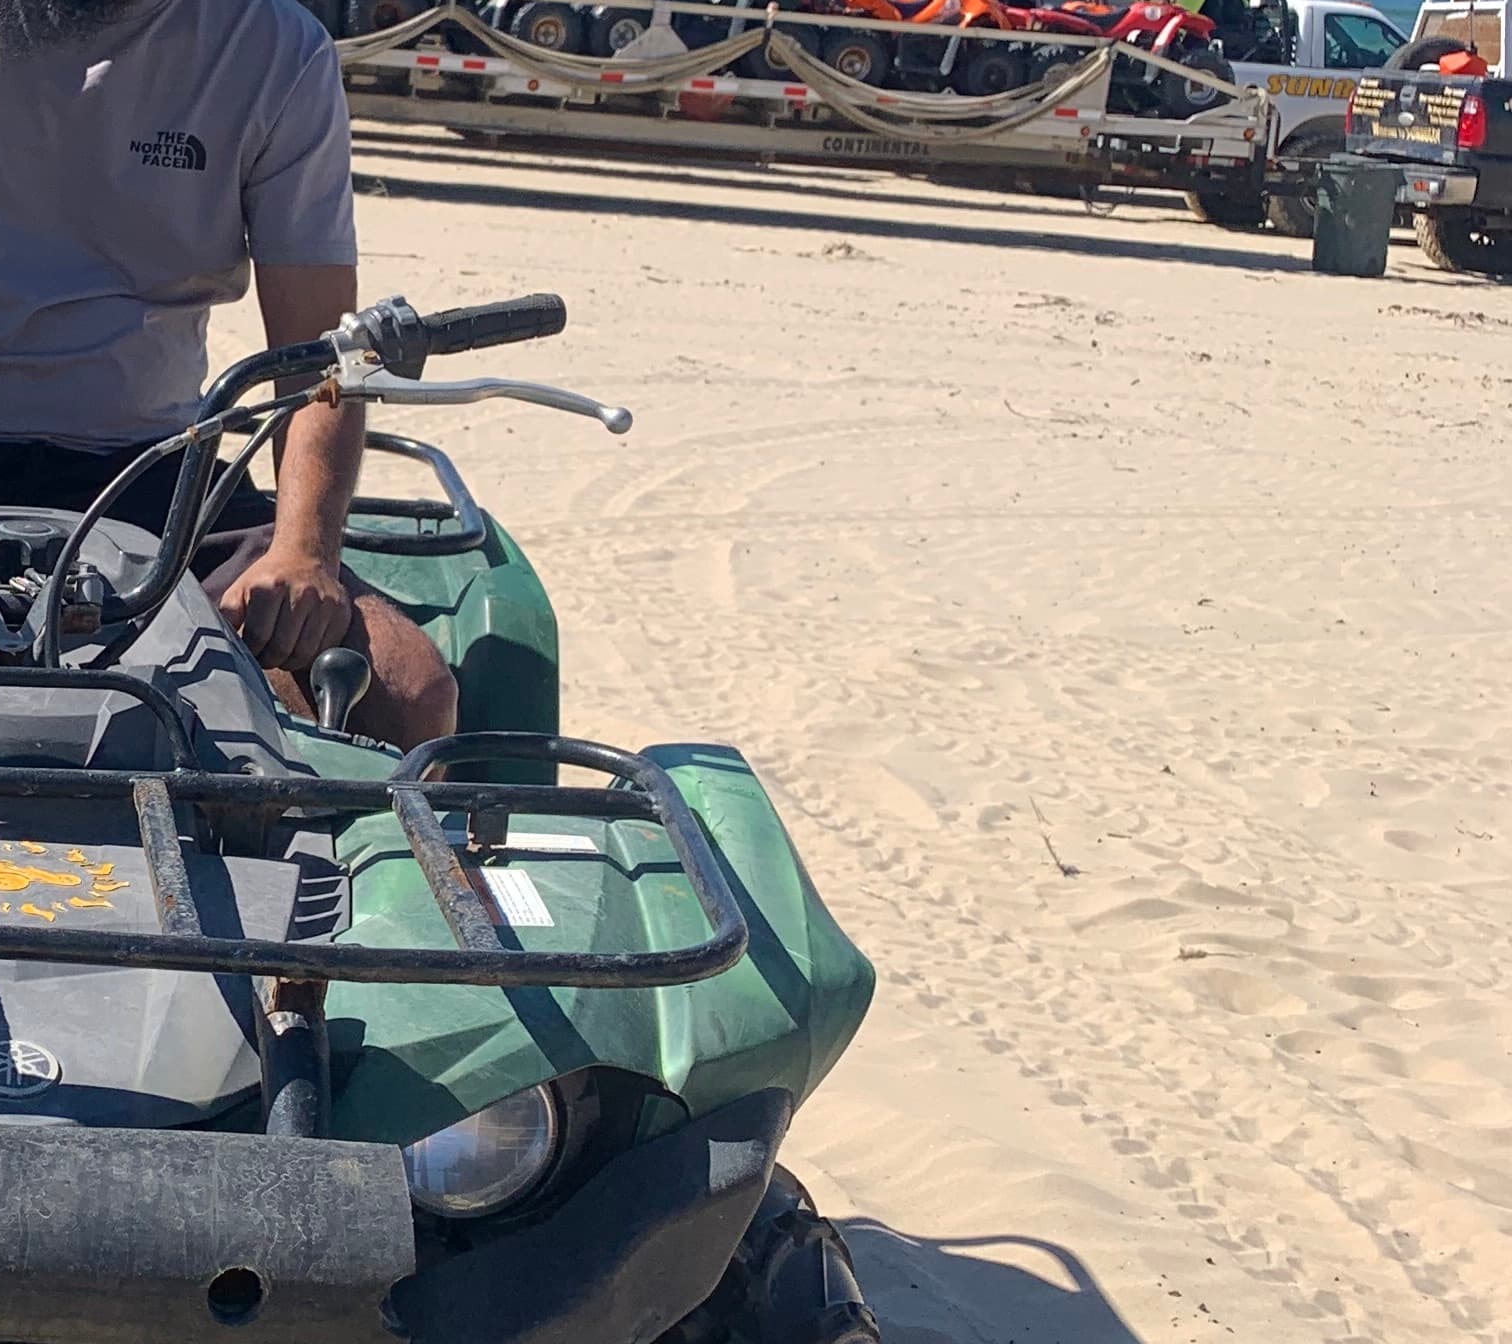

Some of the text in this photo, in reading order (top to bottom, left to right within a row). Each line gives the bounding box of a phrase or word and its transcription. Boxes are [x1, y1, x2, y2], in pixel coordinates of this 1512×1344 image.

[1266, 73, 1355, 98] SUNB
[156, 131, 186, 144] THE
[129, 140, 185, 156] NORTH
[822, 137, 930, 156] CONTINENTAL
[141, 154, 180, 169] FACE
